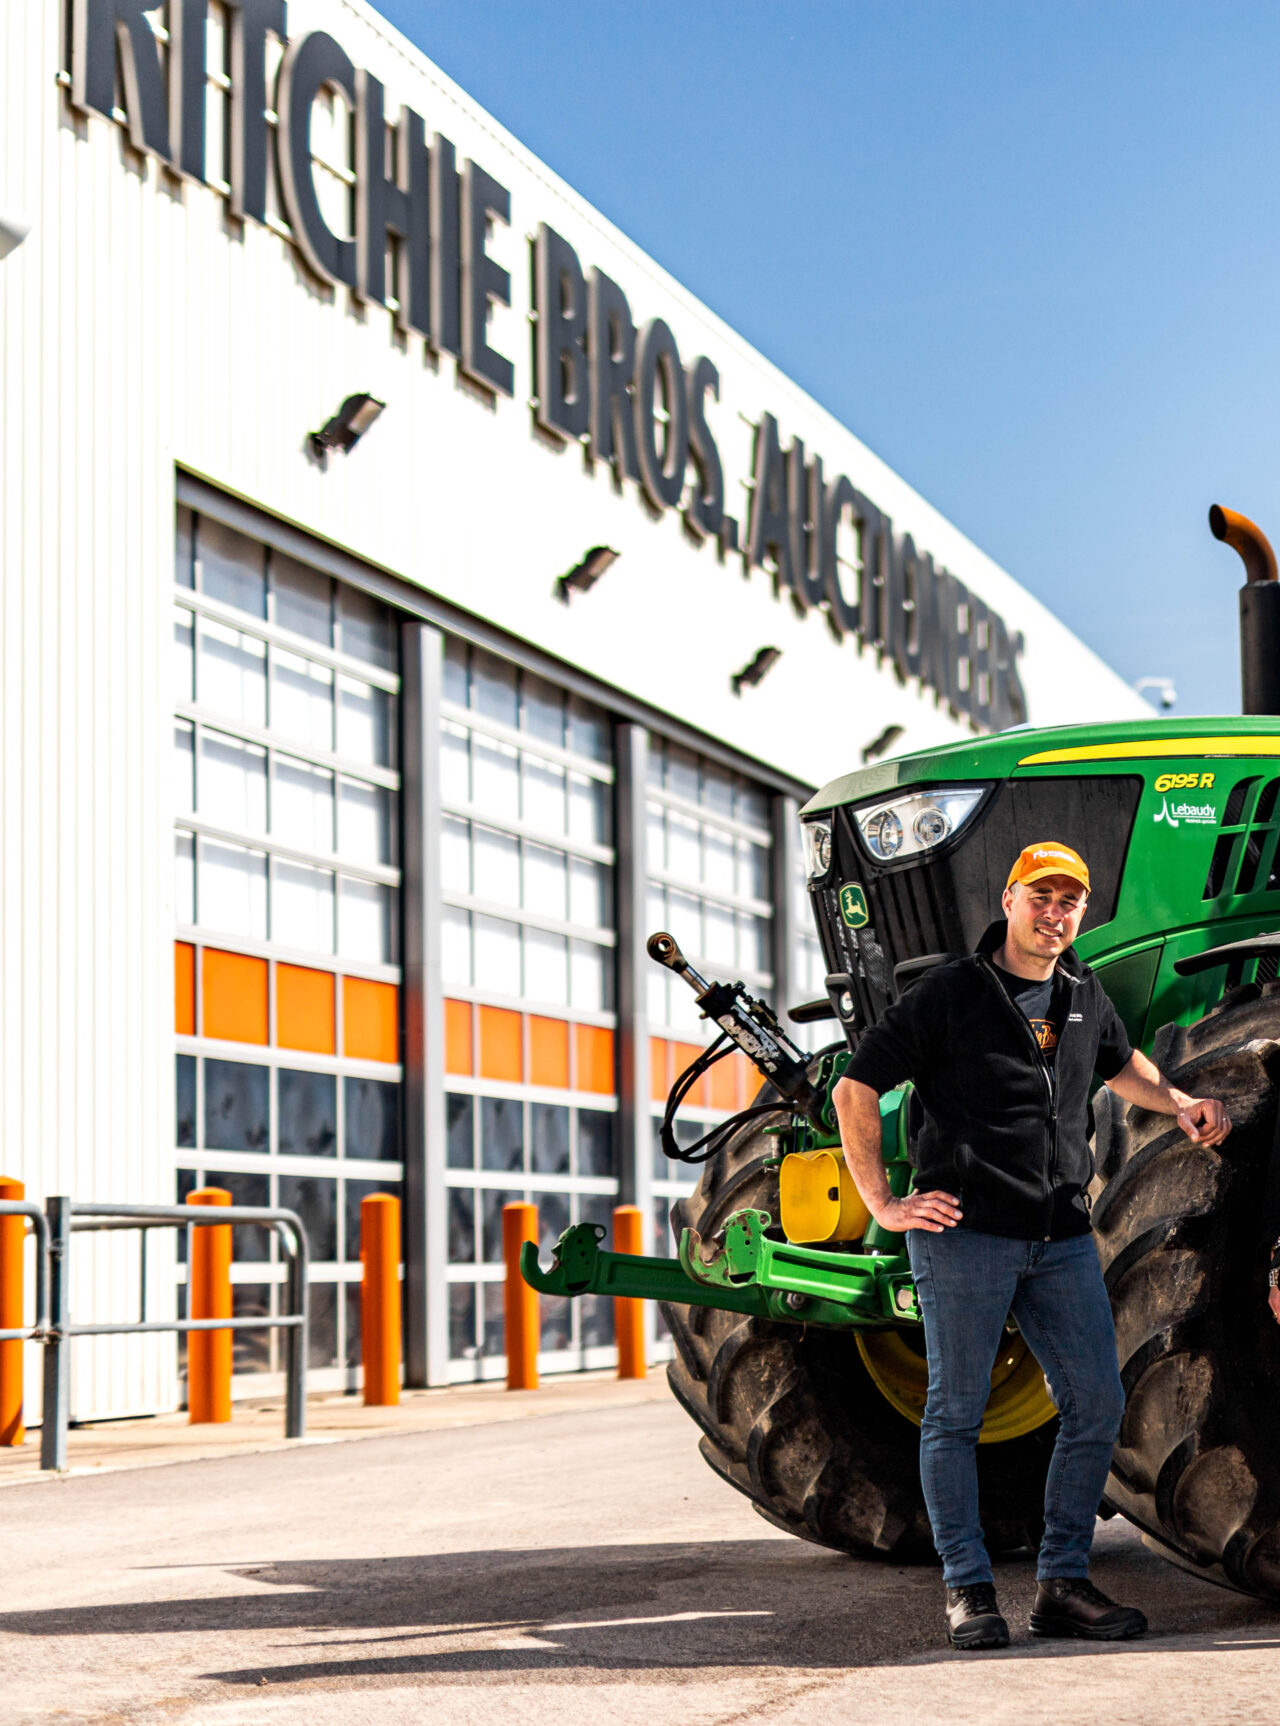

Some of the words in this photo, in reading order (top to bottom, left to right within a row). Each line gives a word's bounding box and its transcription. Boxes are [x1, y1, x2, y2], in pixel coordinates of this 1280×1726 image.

[536, 221, 739, 553] BROS.
[749, 410, 1028, 732] AUCTIONEERS
[1171, 803, 1216, 818] Lebaudy
